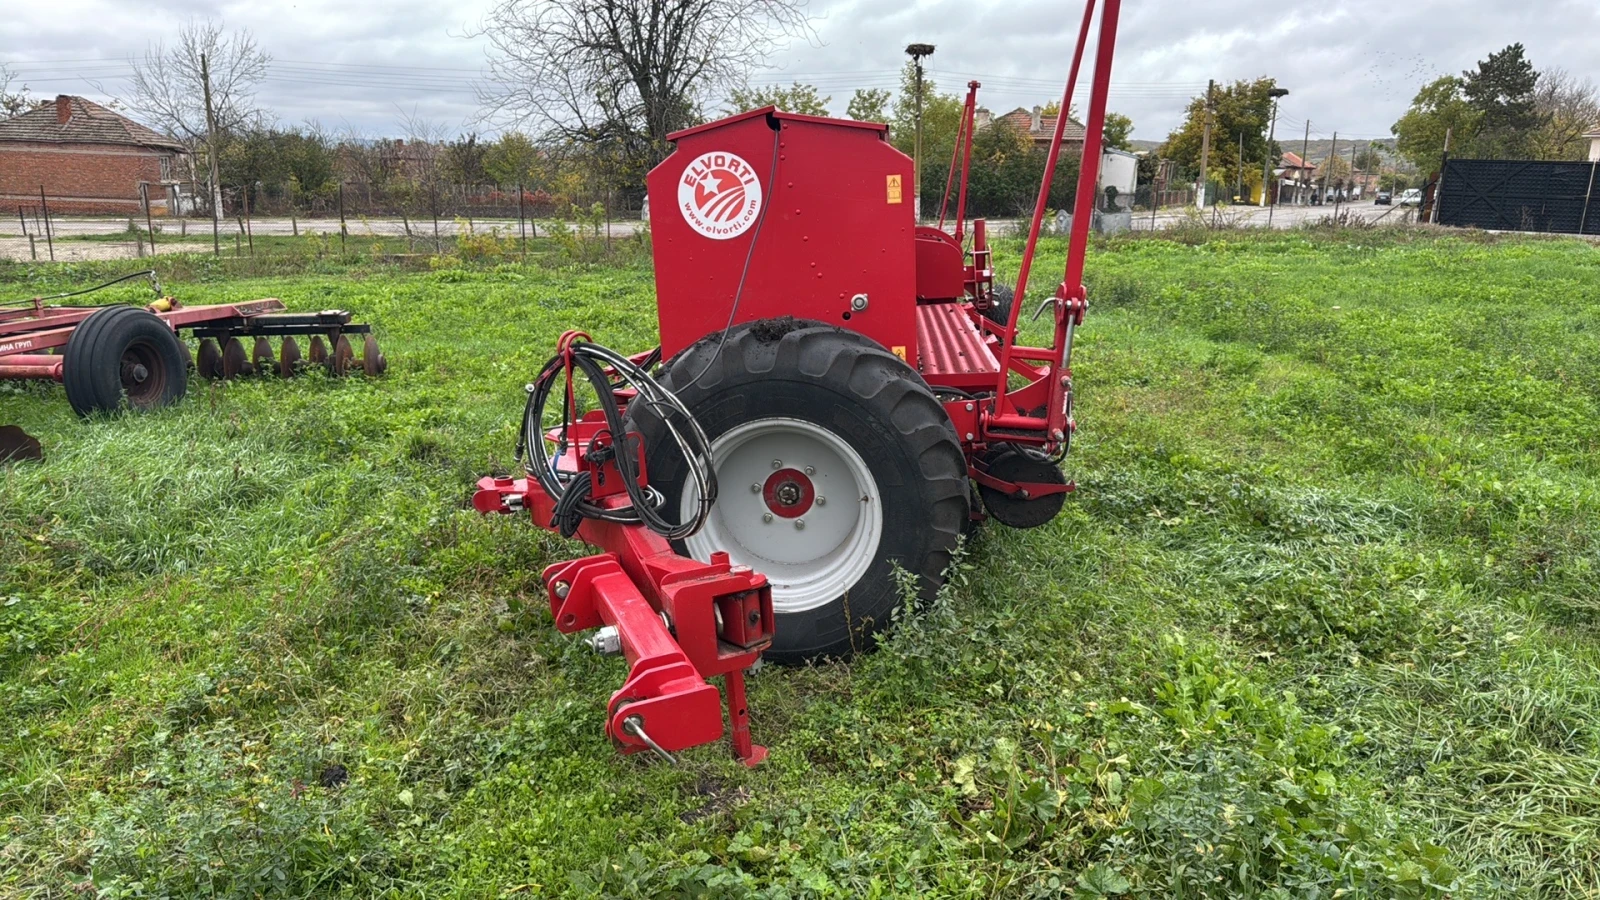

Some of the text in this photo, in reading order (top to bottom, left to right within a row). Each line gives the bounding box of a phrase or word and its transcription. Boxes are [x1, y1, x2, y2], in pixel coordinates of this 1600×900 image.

[683, 155, 755, 188] ELVORTI
[684, 199, 757, 235] www.elvorti.com
[14, 340, 32, 349] ГРУП
